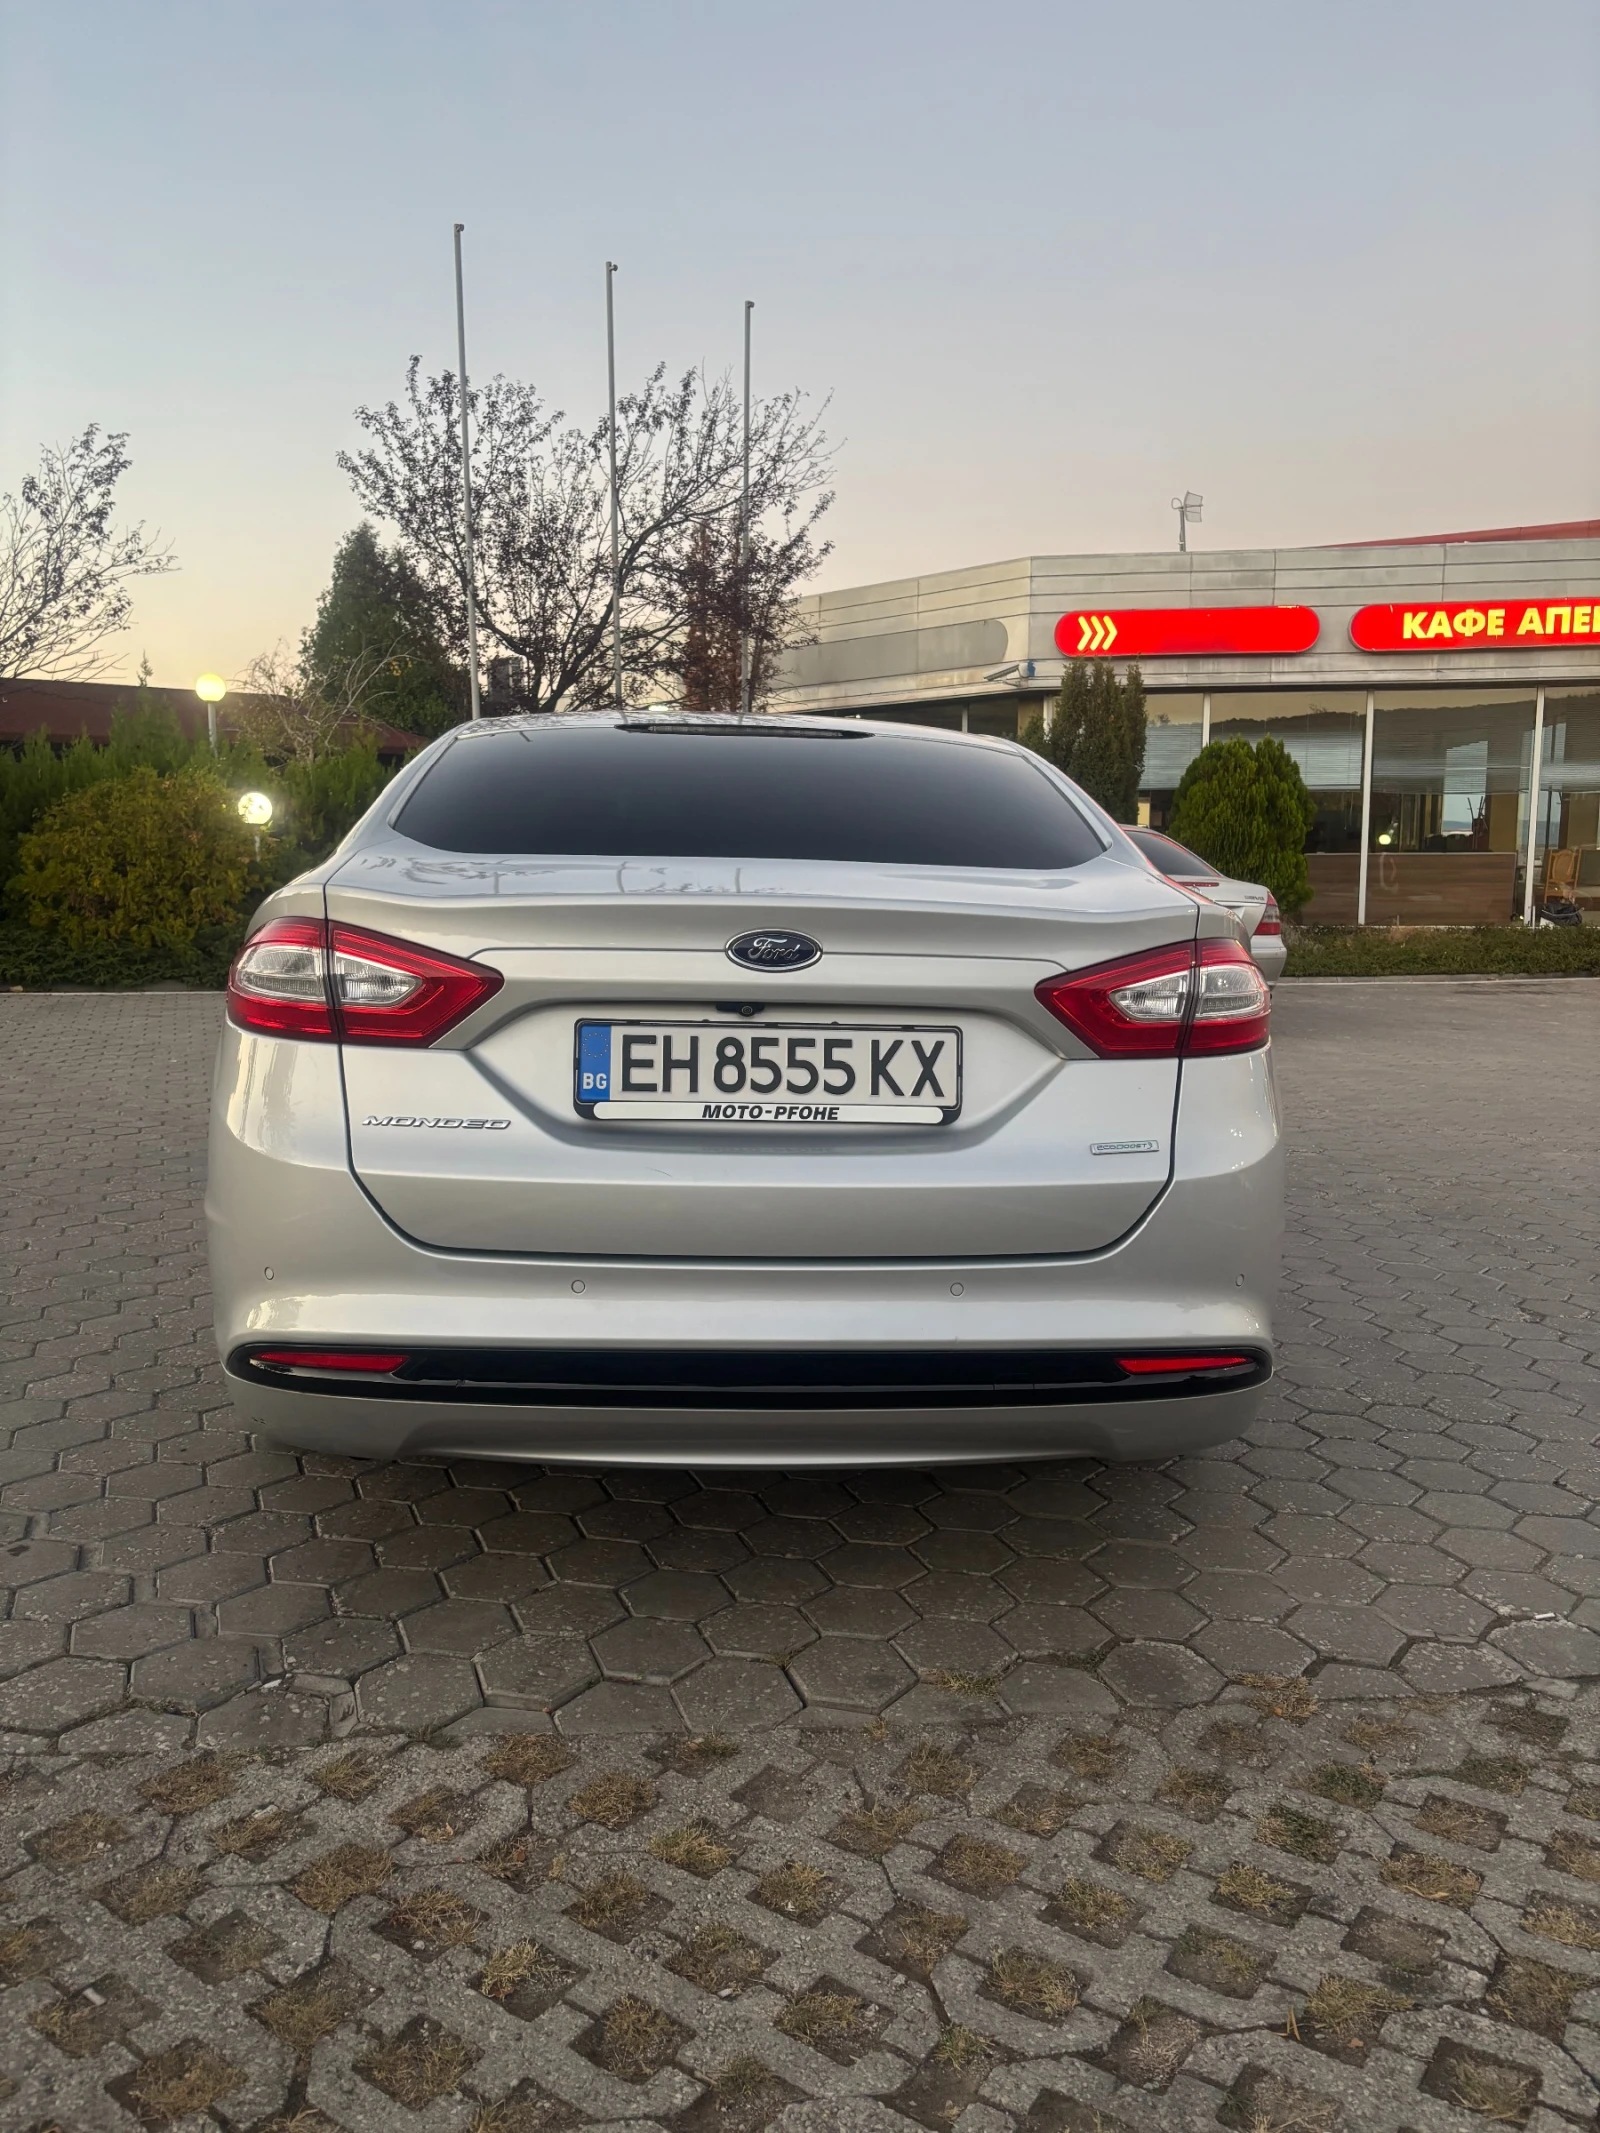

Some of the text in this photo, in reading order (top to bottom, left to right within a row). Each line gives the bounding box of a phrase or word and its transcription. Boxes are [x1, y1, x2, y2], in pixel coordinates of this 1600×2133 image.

[1402, 605, 1600, 639] КАФЕ АПЕ
[748, 937, 800, 962] Ford
[622, 1034, 946, 1098] EH 8555 KX
[582, 1072, 608, 1090] BG
[362, 1115, 512, 1130] MONDEO
[701, 1104, 840, 1121] MOTO-PFOHE
